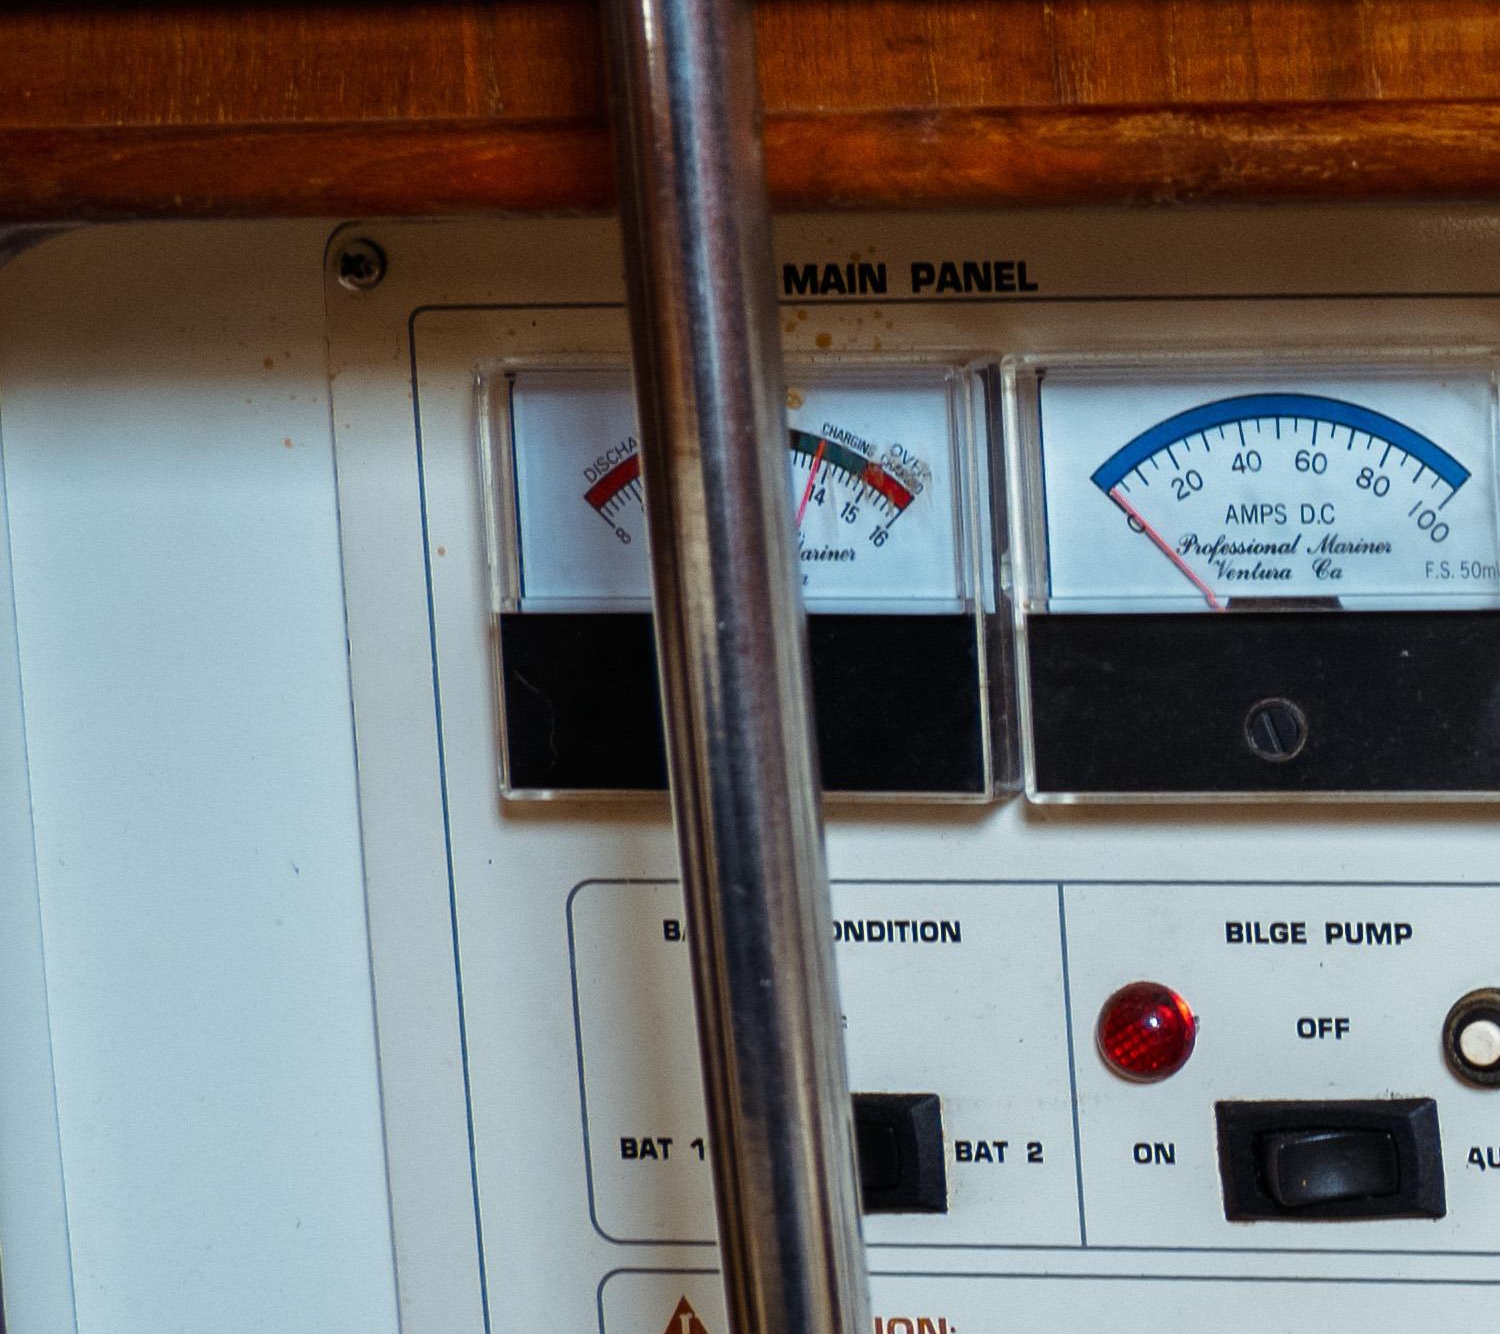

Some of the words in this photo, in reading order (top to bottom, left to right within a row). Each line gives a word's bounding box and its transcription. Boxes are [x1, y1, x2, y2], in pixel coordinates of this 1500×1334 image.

[782, 262, 888, 295] MAIN
[910, 260, 1039, 294] PANEL
[1231, 449, 1262, 474] 40
[1294, 449, 1328, 475] 60
[1170, 468, 1204, 502] 20
[1355, 466, 1390, 497] 80
[1225, 503, 1288, 525] AMPS
[1408, 500, 1449, 544] 100
[1175, 532, 1301, 565] Professional
[1307, 535, 1392, 555] Mariner
[1212, 559, 1292, 581] Ventura
[1311, 558, 1343, 581] Ca
[1225, 921, 1307, 945] BILGE
[1325, 922, 1413, 945] PUMP
[1296, 1017, 1350, 1040] OFF
[620, 1137, 673, 1161] BAT
[689, 1137, 706, 1162] 1
[954, 1140, 1009, 1164] BAT
[1026, 1141, 1044, 1164] 2
[1133, 1142, 1176, 1165] ON
